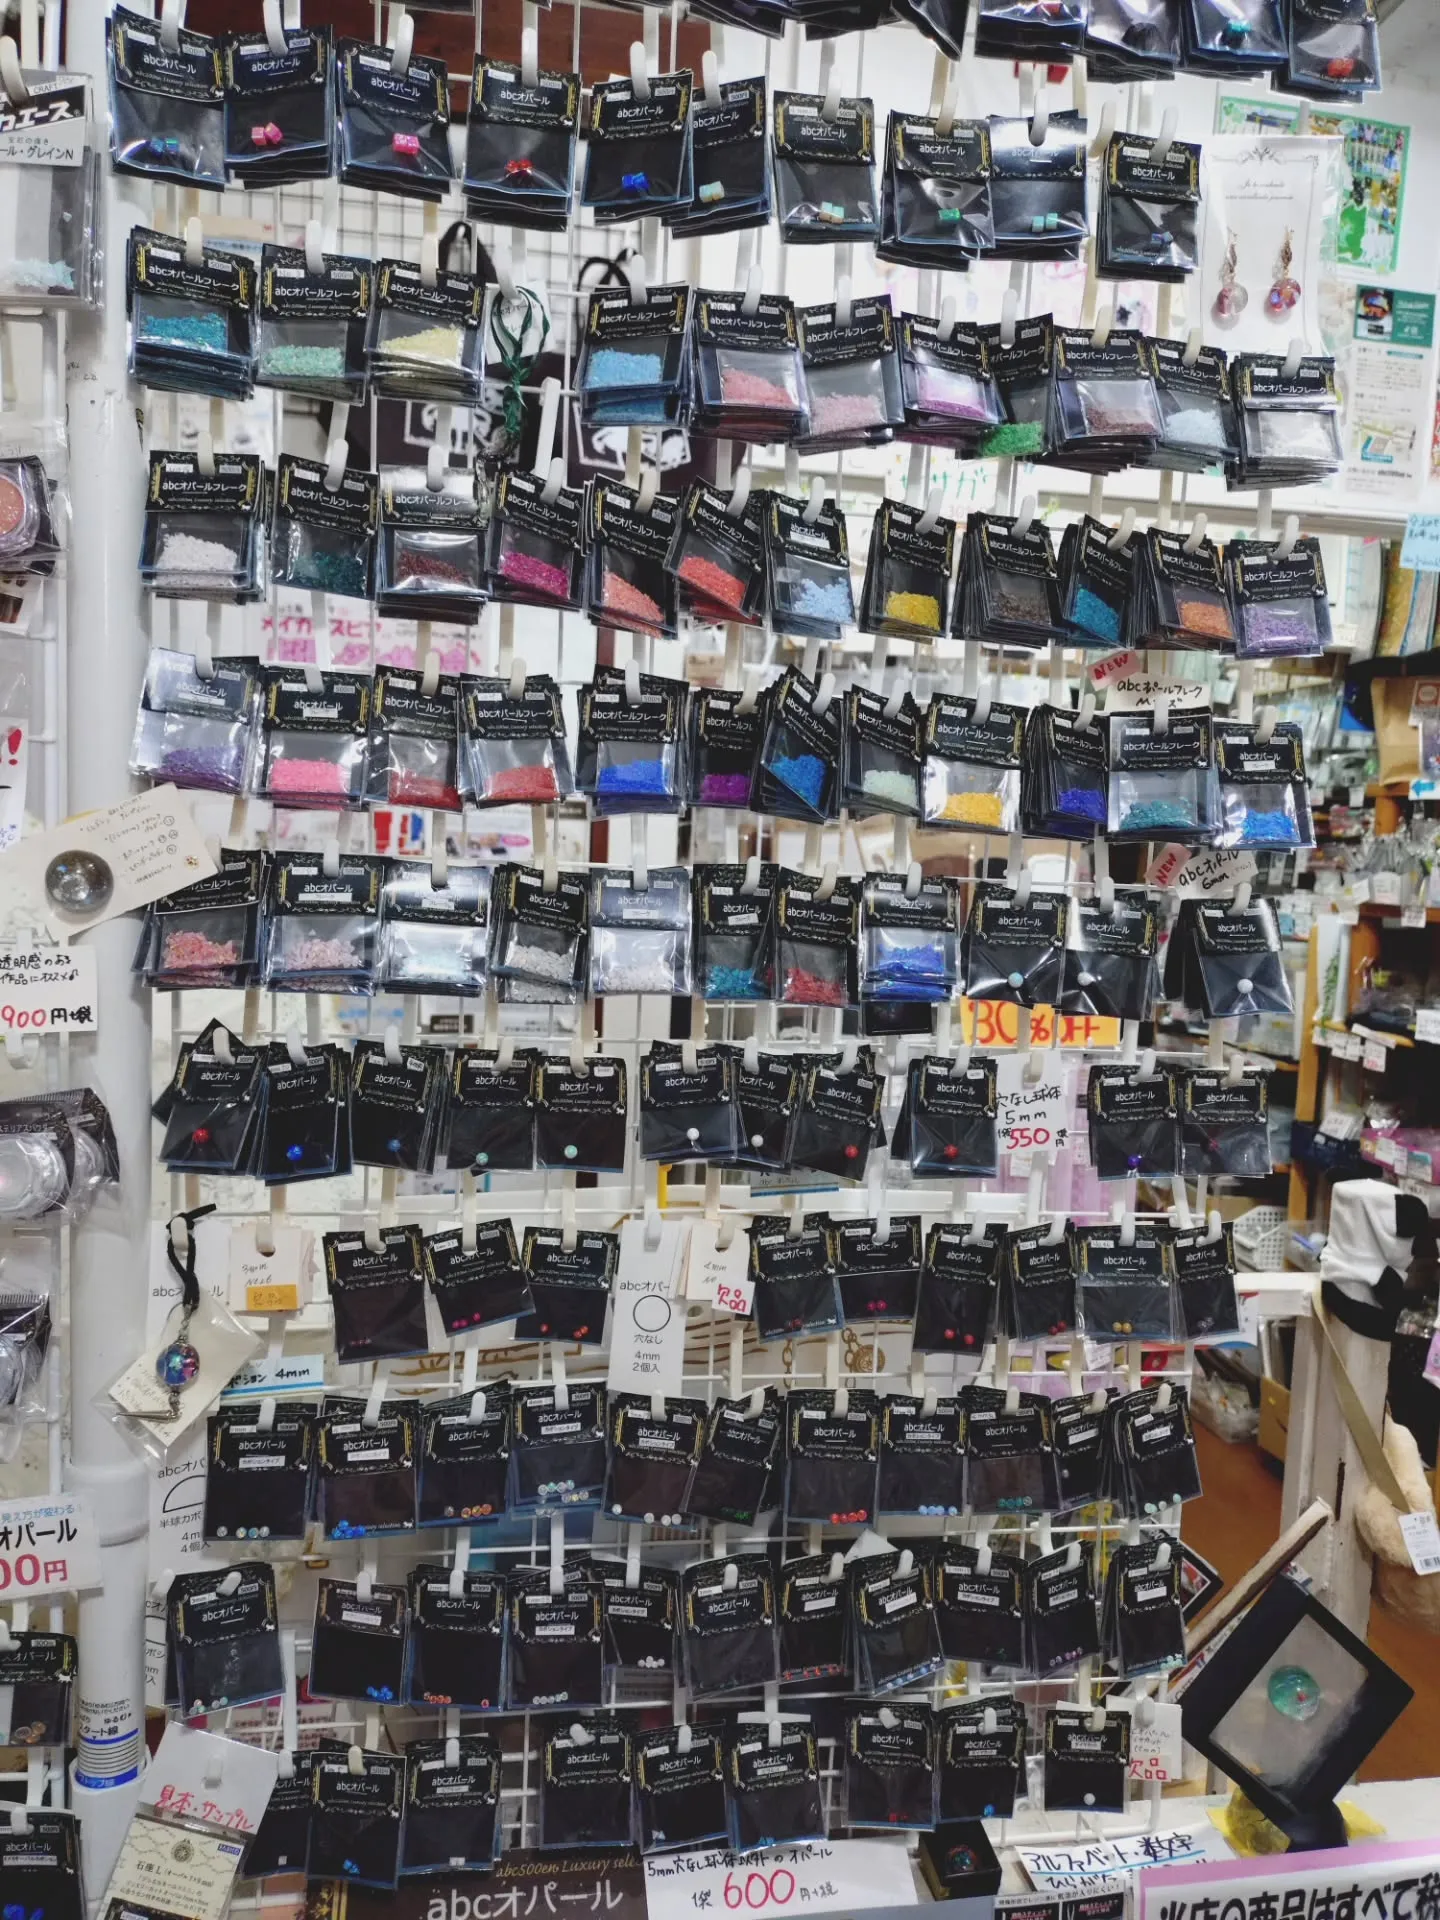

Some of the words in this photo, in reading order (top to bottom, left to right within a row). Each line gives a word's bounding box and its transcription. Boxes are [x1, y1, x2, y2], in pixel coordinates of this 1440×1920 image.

[143, 53, 197, 75] abcオパール
[252, 57, 300, 73] abcオパール
[371, 78, 421, 98] abcオパール
[501, 88, 550, 106] abcオパール
[617, 107, 663, 119] abcオパール
[693, 112, 739, 128] abcオパール
[801, 127, 847, 140] abcオパール
[920, 143, 965, 156] abcオパール
[1132, 167, 1175, 181] abcオパール
[149, 263, 239, 291] abcオパールフレーク
[275, 285, 360, 299] abcオパールフレーク
[391, 283, 473, 306] abcオパールフレーク
[599, 310, 676, 324] abcオパールフレーク
[711, 316, 786, 330] abcオパールフレーク
[806, 325, 883, 345] abcオパールフレーク
[913, 338, 981, 360] abcオパールフレーク
[1066, 352, 1138, 360] abcオパールフレーク
[1160, 363, 1221, 381] abcオパールフレーク
[1253, 384, 1327, 394] abcオパールフレーク
[162, 481, 246, 491] abcオパールフレーク
[291, 486, 369, 511] abcオパールフレーク
[507, 493, 578, 527] abcオパールフレーク
[1244, 570, 1315, 582] abcオパールフレーク
[1093, 653, 1130, 680] NEW
[294, 700, 343, 711] abcオパール
[479, 708, 553, 718] abcオパールフレーク
[592, 710, 666, 720] abcオパールフレーク
[937, 724, 1014, 742] abcオパールフレーク
[1124, 741, 1200, 755] abcオパールフレーク
[1240, 751, 1280, 761] abcオパール
[1156, 852, 1177, 885] NEW
[304, 884, 352, 893] abcオパール
[529, 894, 569, 910] abcオパール
[618, 896, 662, 906] abcオパール
[890, 899, 932, 909] abcオパール
[723, 903, 762, 913] abcオパール
[787, 907, 852, 924] abcオパールフレーク
[998, 917, 1041, 926] abcオパール
[1086, 923, 1130, 934] abcオパール
[1218, 924, 1256, 933] abcオパール
[200, 1071, 240, 1081] abcオパール
[374, 1073, 412, 1089] abcオパール
[475, 1076, 516, 1087] abcオパール
[665, 1075, 707, 1087] abcオパール
[277, 1078, 317, 1092] abcオパール
[560, 1081, 604, 1094] abcオパール
[936, 1083, 975, 1096] abcオパール
[827, 1086, 863, 1105] abcオパール
[1115, 1091, 1155, 1101] abcオパール
[1206, 1093, 1249, 1102] abcオパール
[1006, 1127, 1051, 1150] 550
[635, 1351, 660, 1361] 4mm
[275, 1368, 310, 1380] 4mm
[632, 1362, 661, 1374] 2個入
[539, 1410, 581, 1423] abcオパール
[814, 1427, 856, 1439] abcオパール
[904, 1422, 945, 1433] abcオパール
[985, 1425, 1027, 1436] abcオパール
[449, 1429, 490, 1442] abcオパール
[638, 1428, 680, 1441] abcオパール
[239, 1440, 286, 1451] abcオパール
[343, 1438, 389, 1451] abcオパール
[0, 1518, 77, 1552] オパール
[436, 1599, 480, 1610] abcオパール
[708, 1599, 750, 1613] abcオパール
[202, 1604, 249, 1622] abcオパール
[535, 1611, 578, 1621] abcオパール
[872, 1734, 913, 1746] abcオパール
[566, 1754, 610, 1767] abcオパール
[659, 1756, 701, 1772] abcオパール
[753, 1754, 794, 1768] abcオパール
[1128, 1757, 1168, 1780] 欠品
[432, 1775, 475, 1786] abcオパール
[337, 1782, 380, 1793] abcオパール
[724, 1868, 796, 1910] 600
[427, 1880, 624, 1920] abcオパール
